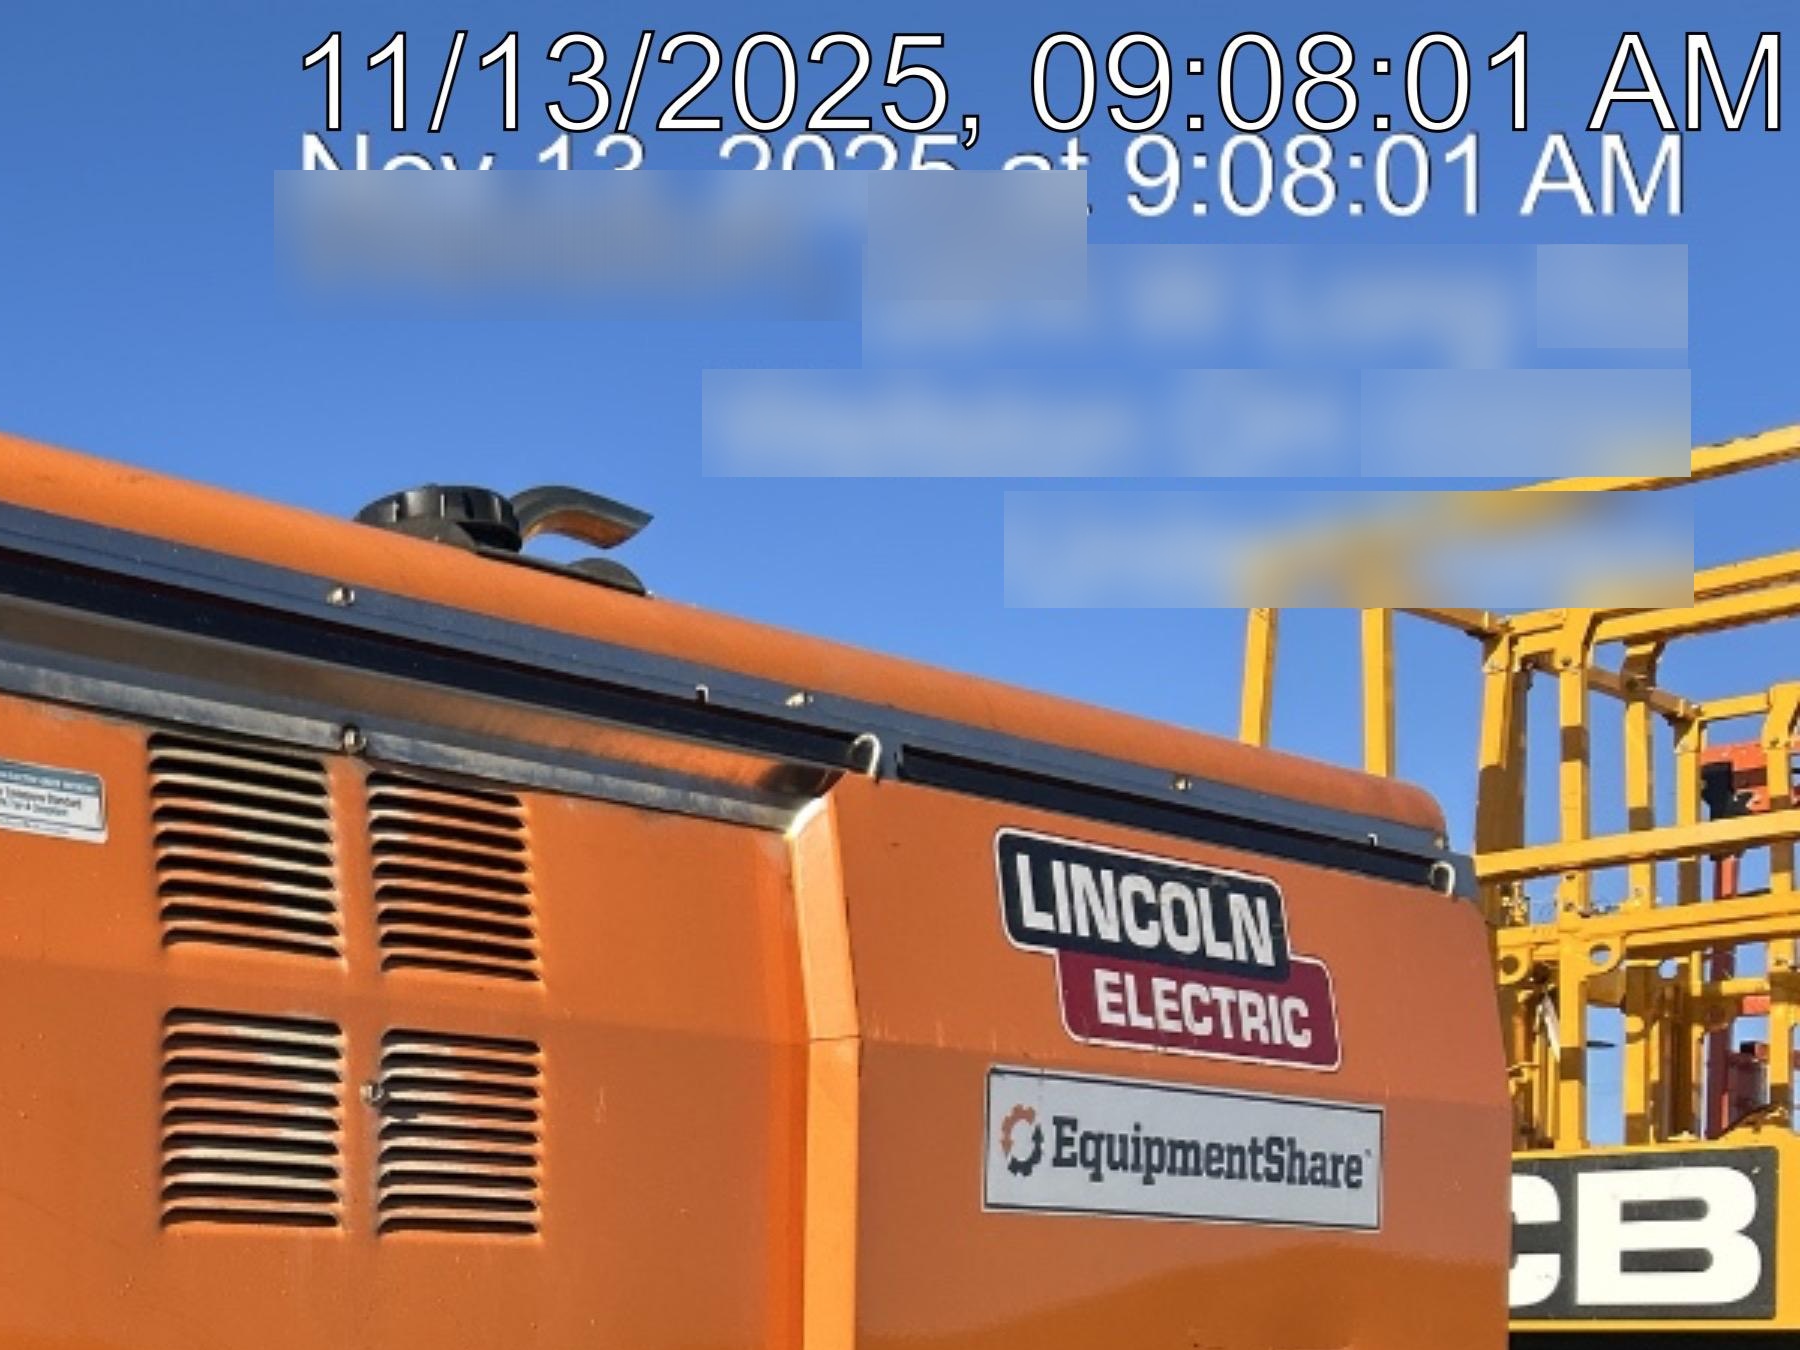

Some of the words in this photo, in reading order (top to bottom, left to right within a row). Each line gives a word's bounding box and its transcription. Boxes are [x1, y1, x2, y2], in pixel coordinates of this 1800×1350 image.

[1014, 852, 1277, 968] LINCOLN
[1093, 968, 1313, 1050] ELECTRIC
[1051, 1115, 1364, 1190] EquipmentShare
